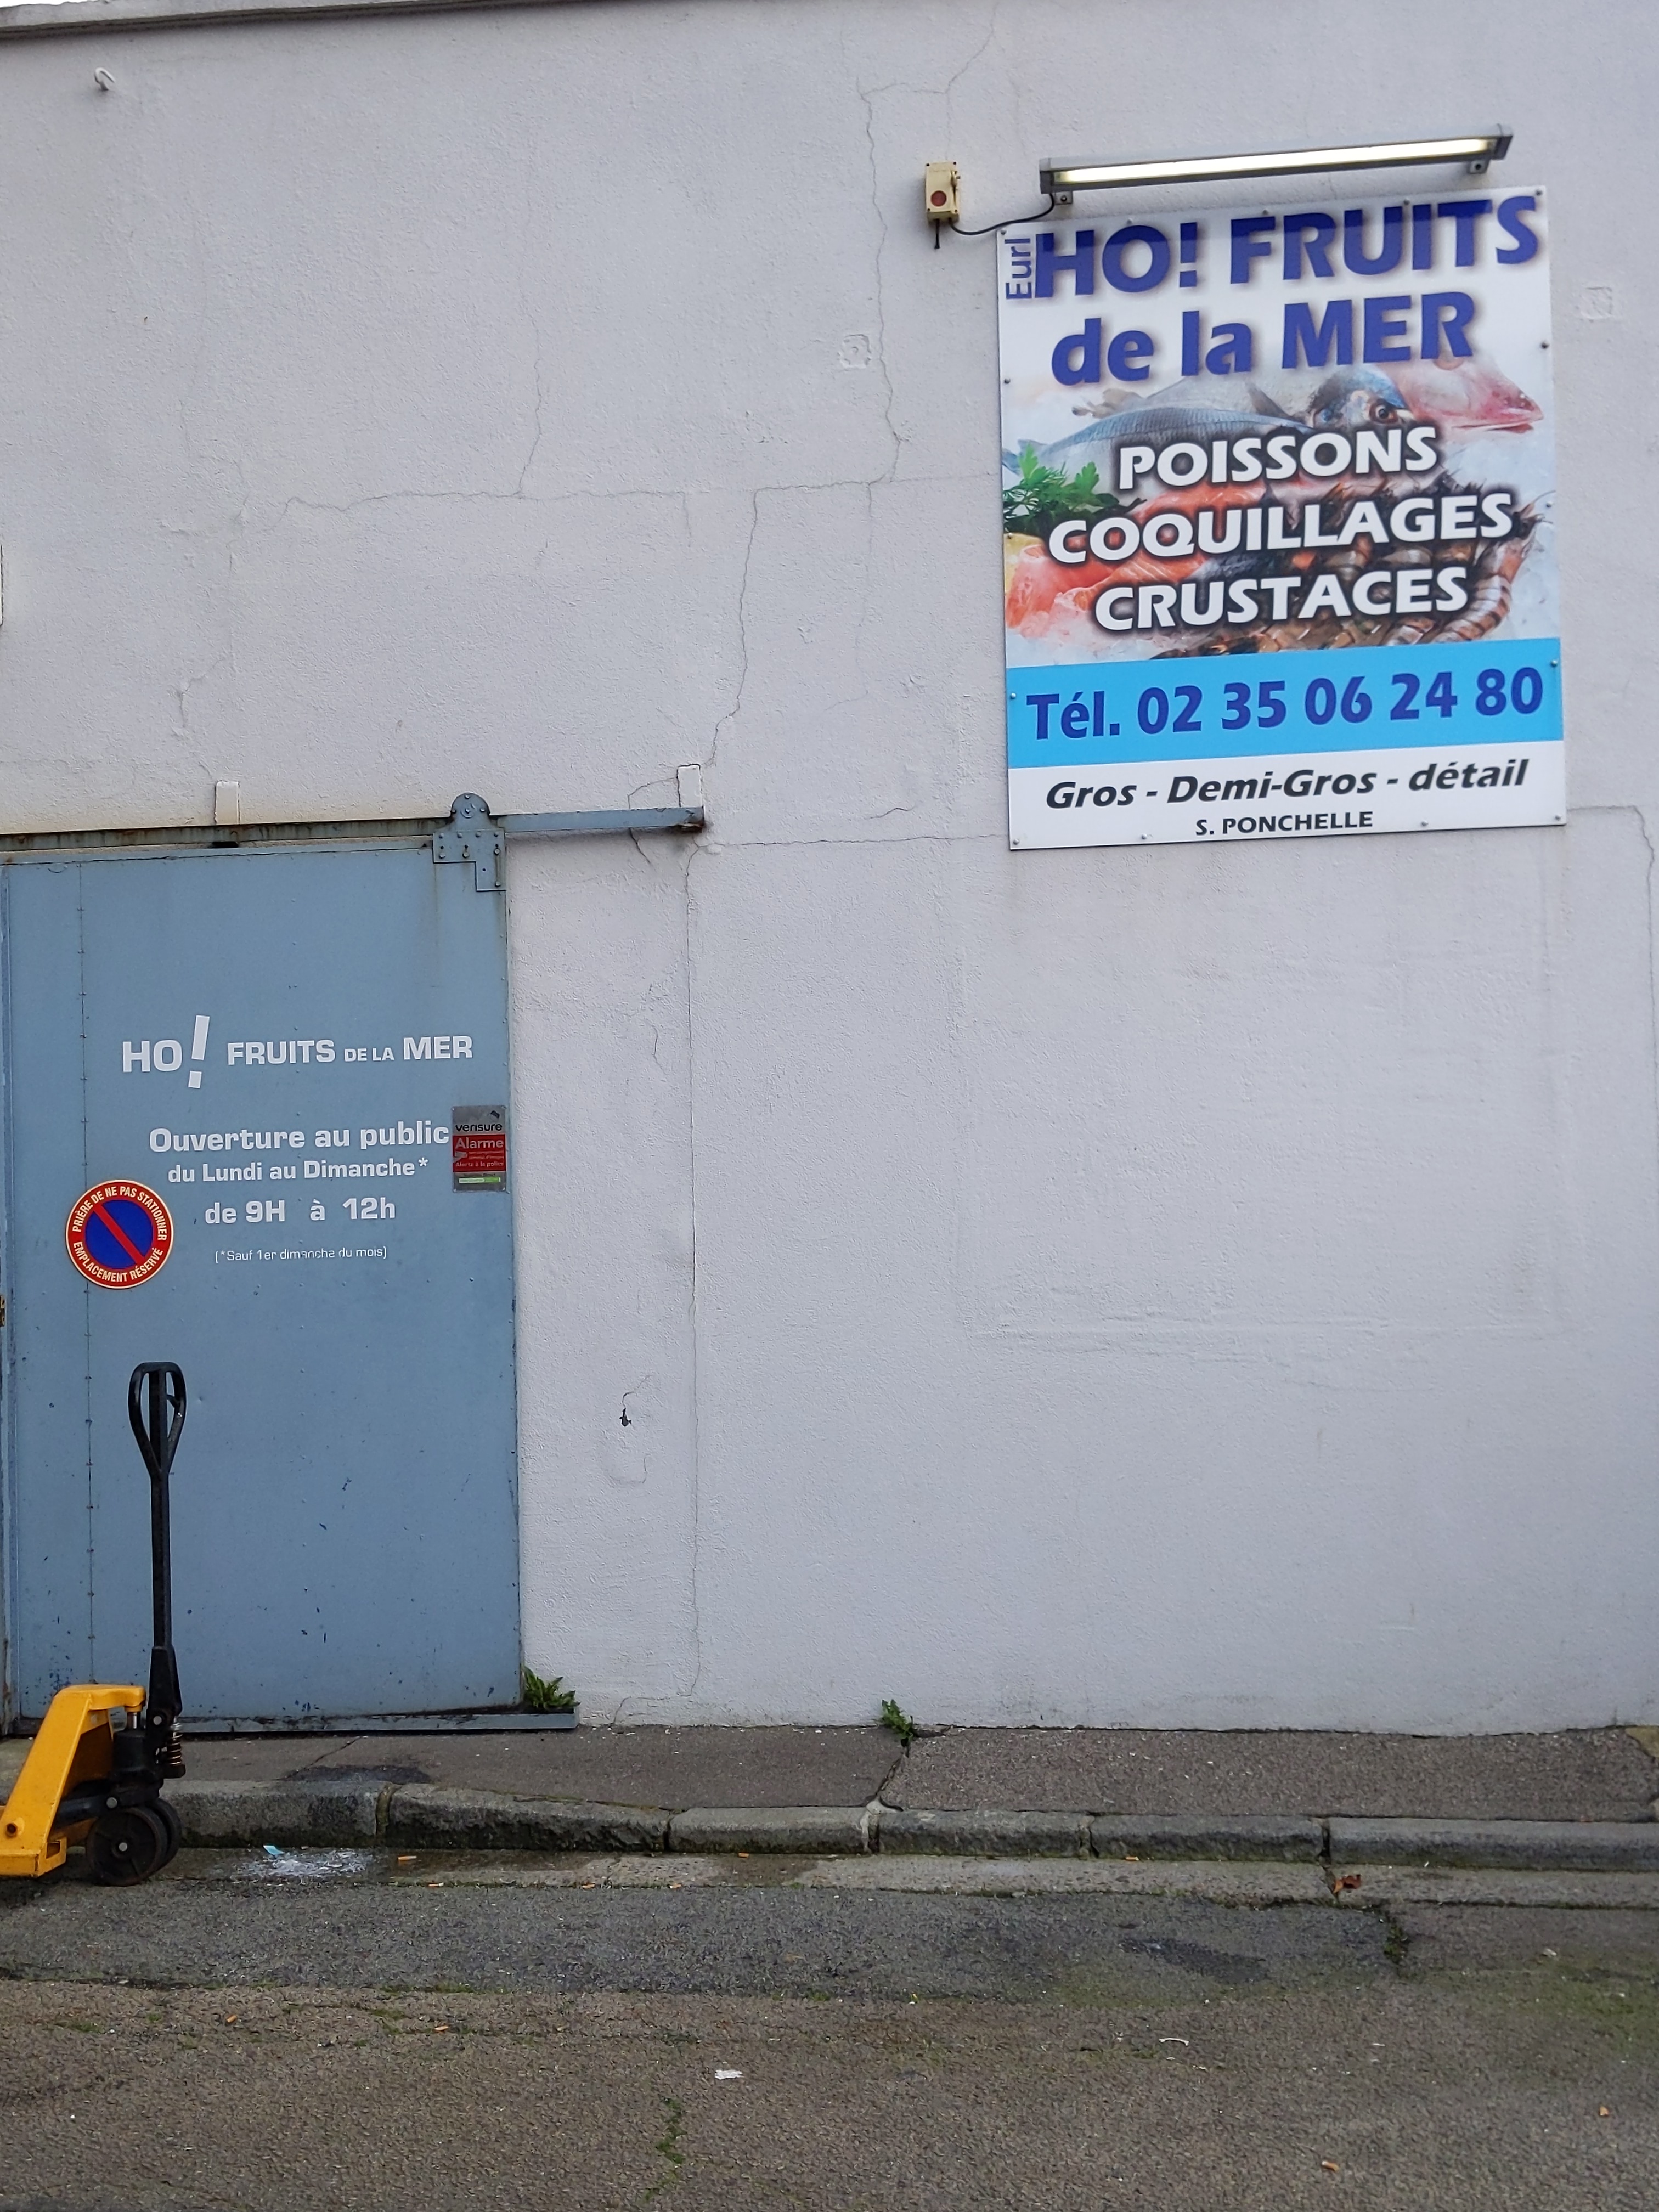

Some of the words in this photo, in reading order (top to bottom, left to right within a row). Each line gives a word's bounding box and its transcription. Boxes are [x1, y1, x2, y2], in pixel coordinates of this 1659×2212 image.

[1005, 237, 1032, 300] Eurl
[1035, 222, 1198, 299] HO!
[1229, 195, 1537, 284] FRUITS
[1051, 318, 1154, 385] de
[1181, 311, 1253, 376] la
[1282, 291, 1475, 369] MER
[1119, 428, 1437, 490] POISSONS
[1048, 493, 1513, 563] COQUILLAGES
[1096, 566, 1468, 631] CRUSTACES
[1026, 690, 1121, 740] Tél.
[1137, 685, 1203, 734] 02
[1221, 680, 1286, 730] 35
[1305, 676, 1373, 725] 06
[1389, 671, 1458, 720] 24
[1475, 667, 1543, 715] 80
[1046, 781, 1136, 809] Gros
[1166, 769, 1375, 804] Demi-Gros
[1408, 759, 1529, 791] détail
[1195, 819, 1215, 836] S.
[1222, 811, 1373, 834] PONCHELLE
[121, 1015, 210, 1089] HO!
[227, 1040, 335, 1066] FRUITS
[345, 1048, 368, 1063] DE
[372, 1047, 395, 1061] LA
[403, 1036, 473, 1060] MER
[149, 1128, 306, 1153] Ouverture
[314, 1127, 351, 1148] au
[359, 1120, 449, 1150] public
[455, 1124, 503, 1132] verisure
[455, 1137, 504, 1149] Alarme
[168, 1164, 195, 1183] du
[202, 1161, 263, 1182] Lundi
[269, 1163, 297, 1180] au
[72, 1200, 93, 1232] PRIÈRE
[91, 1191, 104, 1204] DE
[105, 1186, 117, 1198] NE
[120, 1186, 137, 1198] PAS
[137, 1192, 167, 1241] STATIONNER
[205, 1202, 237, 1225] de
[246, 1200, 286, 1223] 9H
[310, 1199, 326, 1222] à
[342, 1197, 396, 1220] 12h
[74, 1242, 128, 1282] EMPLACEMENT
[129, 1247, 163, 1280] RÉSERVÉ
[257, 1250, 276, 1260] 1er
[280, 1248, 335, 1259] dimanche
[338, 1247, 352, 1257] du
[356, 1246, 387, 1259] mois)
